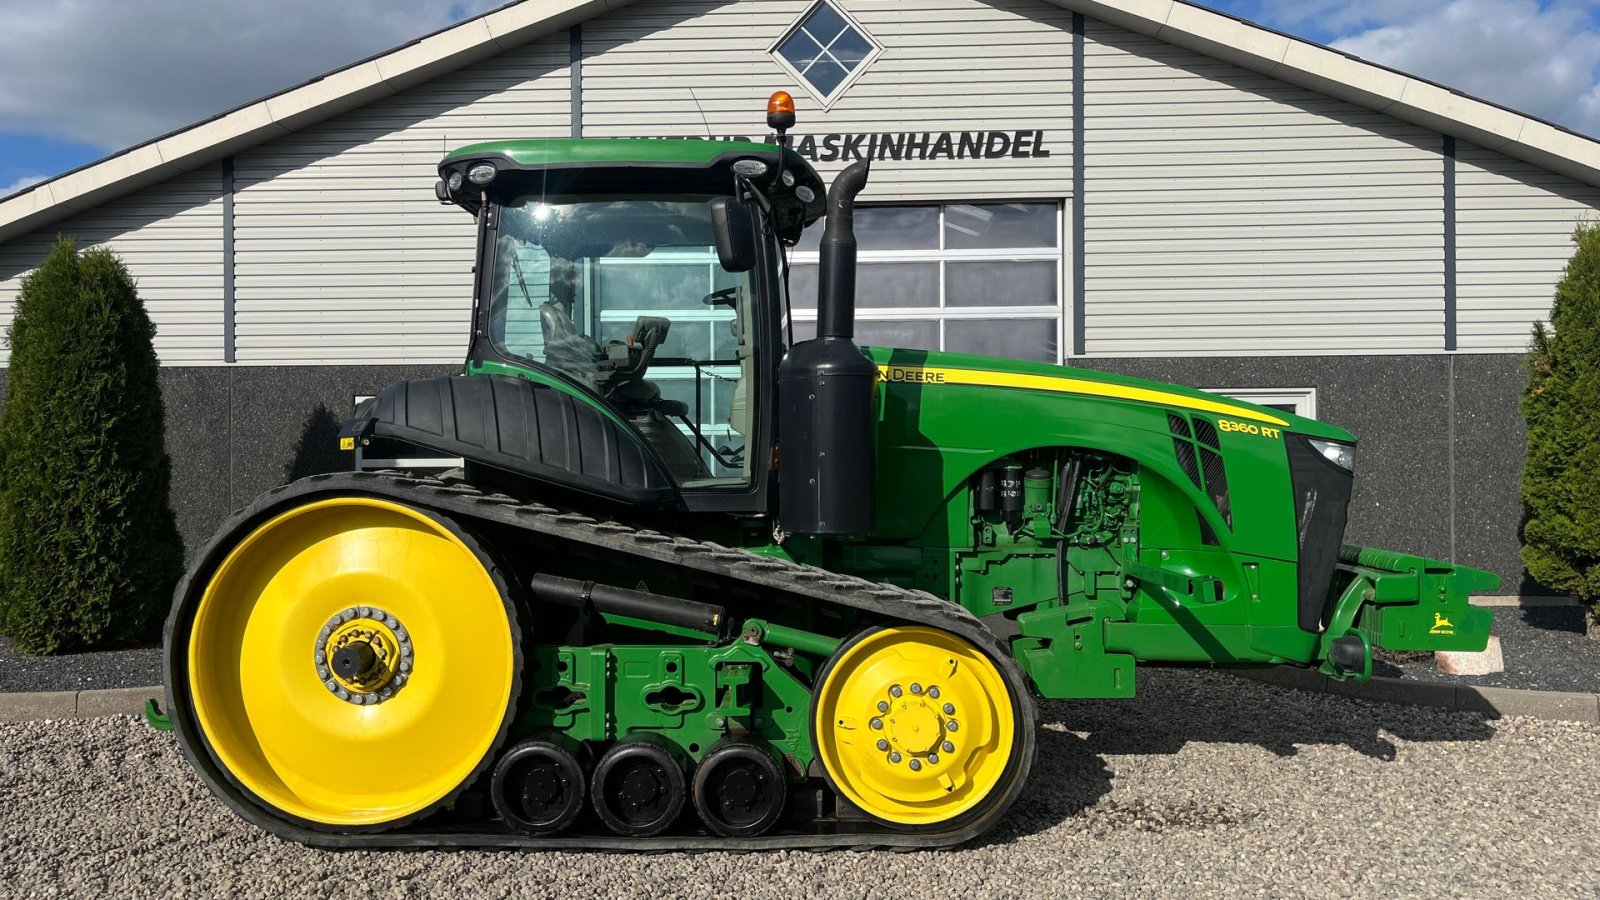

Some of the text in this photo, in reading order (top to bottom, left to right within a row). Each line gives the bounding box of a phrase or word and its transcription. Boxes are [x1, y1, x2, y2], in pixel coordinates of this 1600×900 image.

[893, 368, 945, 382] DEERE
[1218, 419, 1280, 439] 8360 RT
